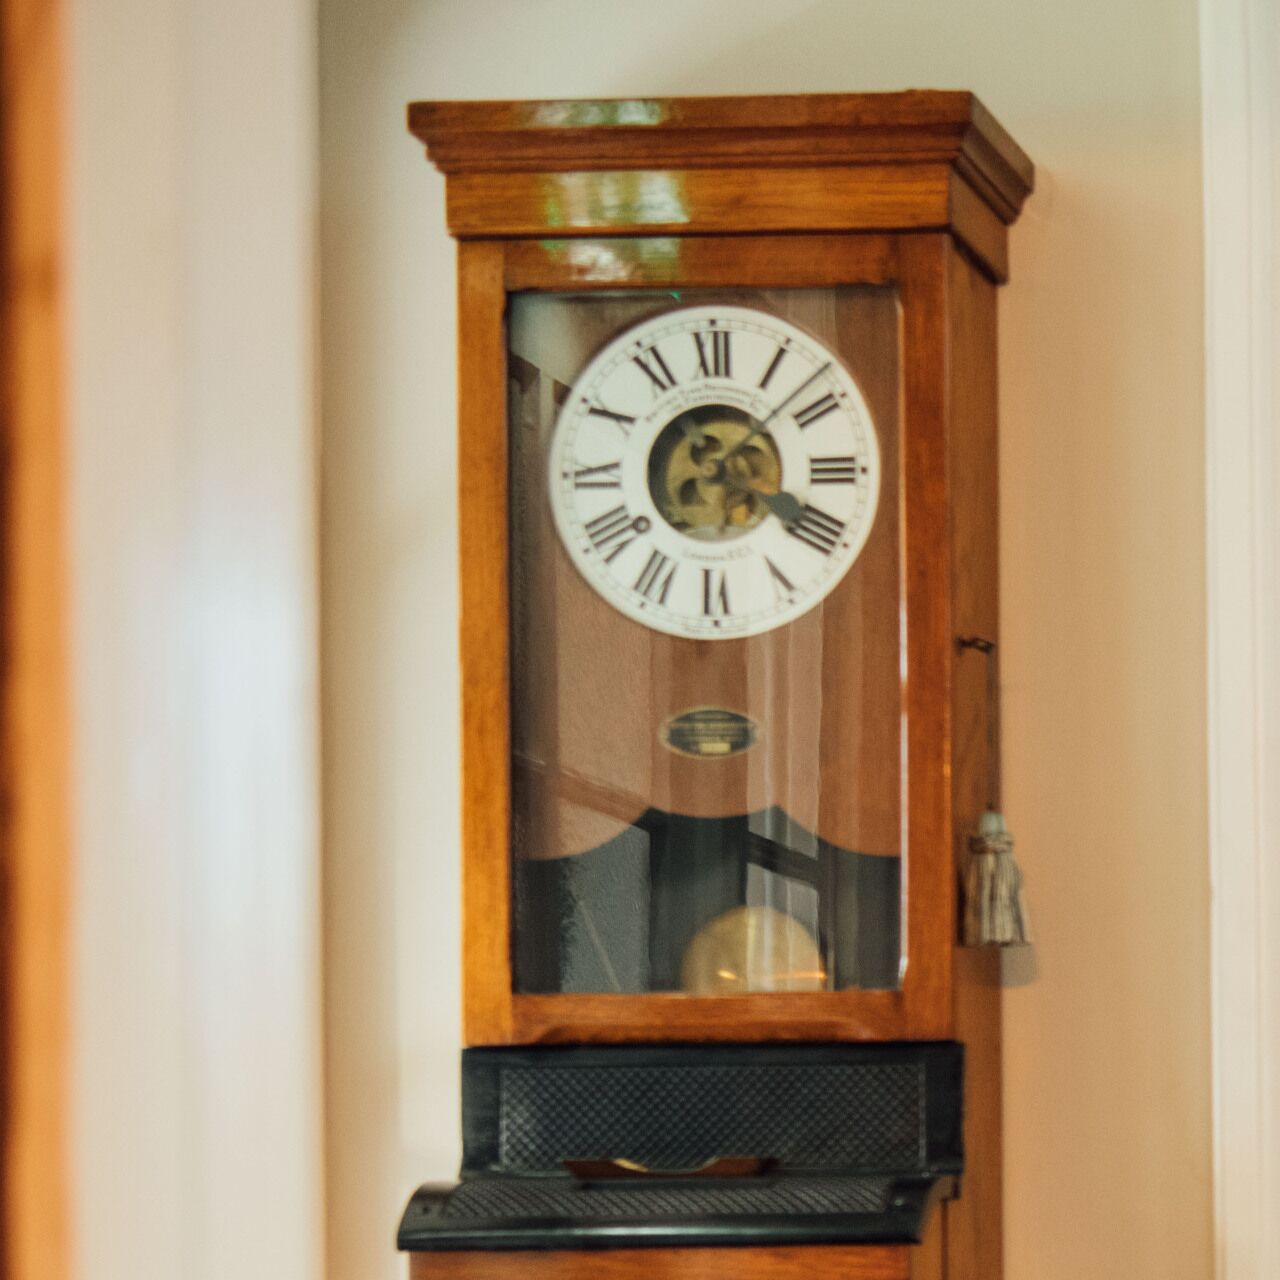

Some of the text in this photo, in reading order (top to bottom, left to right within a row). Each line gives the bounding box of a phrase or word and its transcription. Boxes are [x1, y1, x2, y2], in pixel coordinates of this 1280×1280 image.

[633, 345, 678, 394] XI
[692, 330, 733, 379] XII
[758, 346, 788, 389] I
[588, 398, 638, 438] X
[793, 391, 841, 429] II
[574, 461, 622, 492] IX
[810, 456, 857, 485] III
[583, 504, 642, 564] VIII
[632, 548, 680, 606] VII
[701, 568, 731, 617] VI
[763, 555, 797, 604] V
